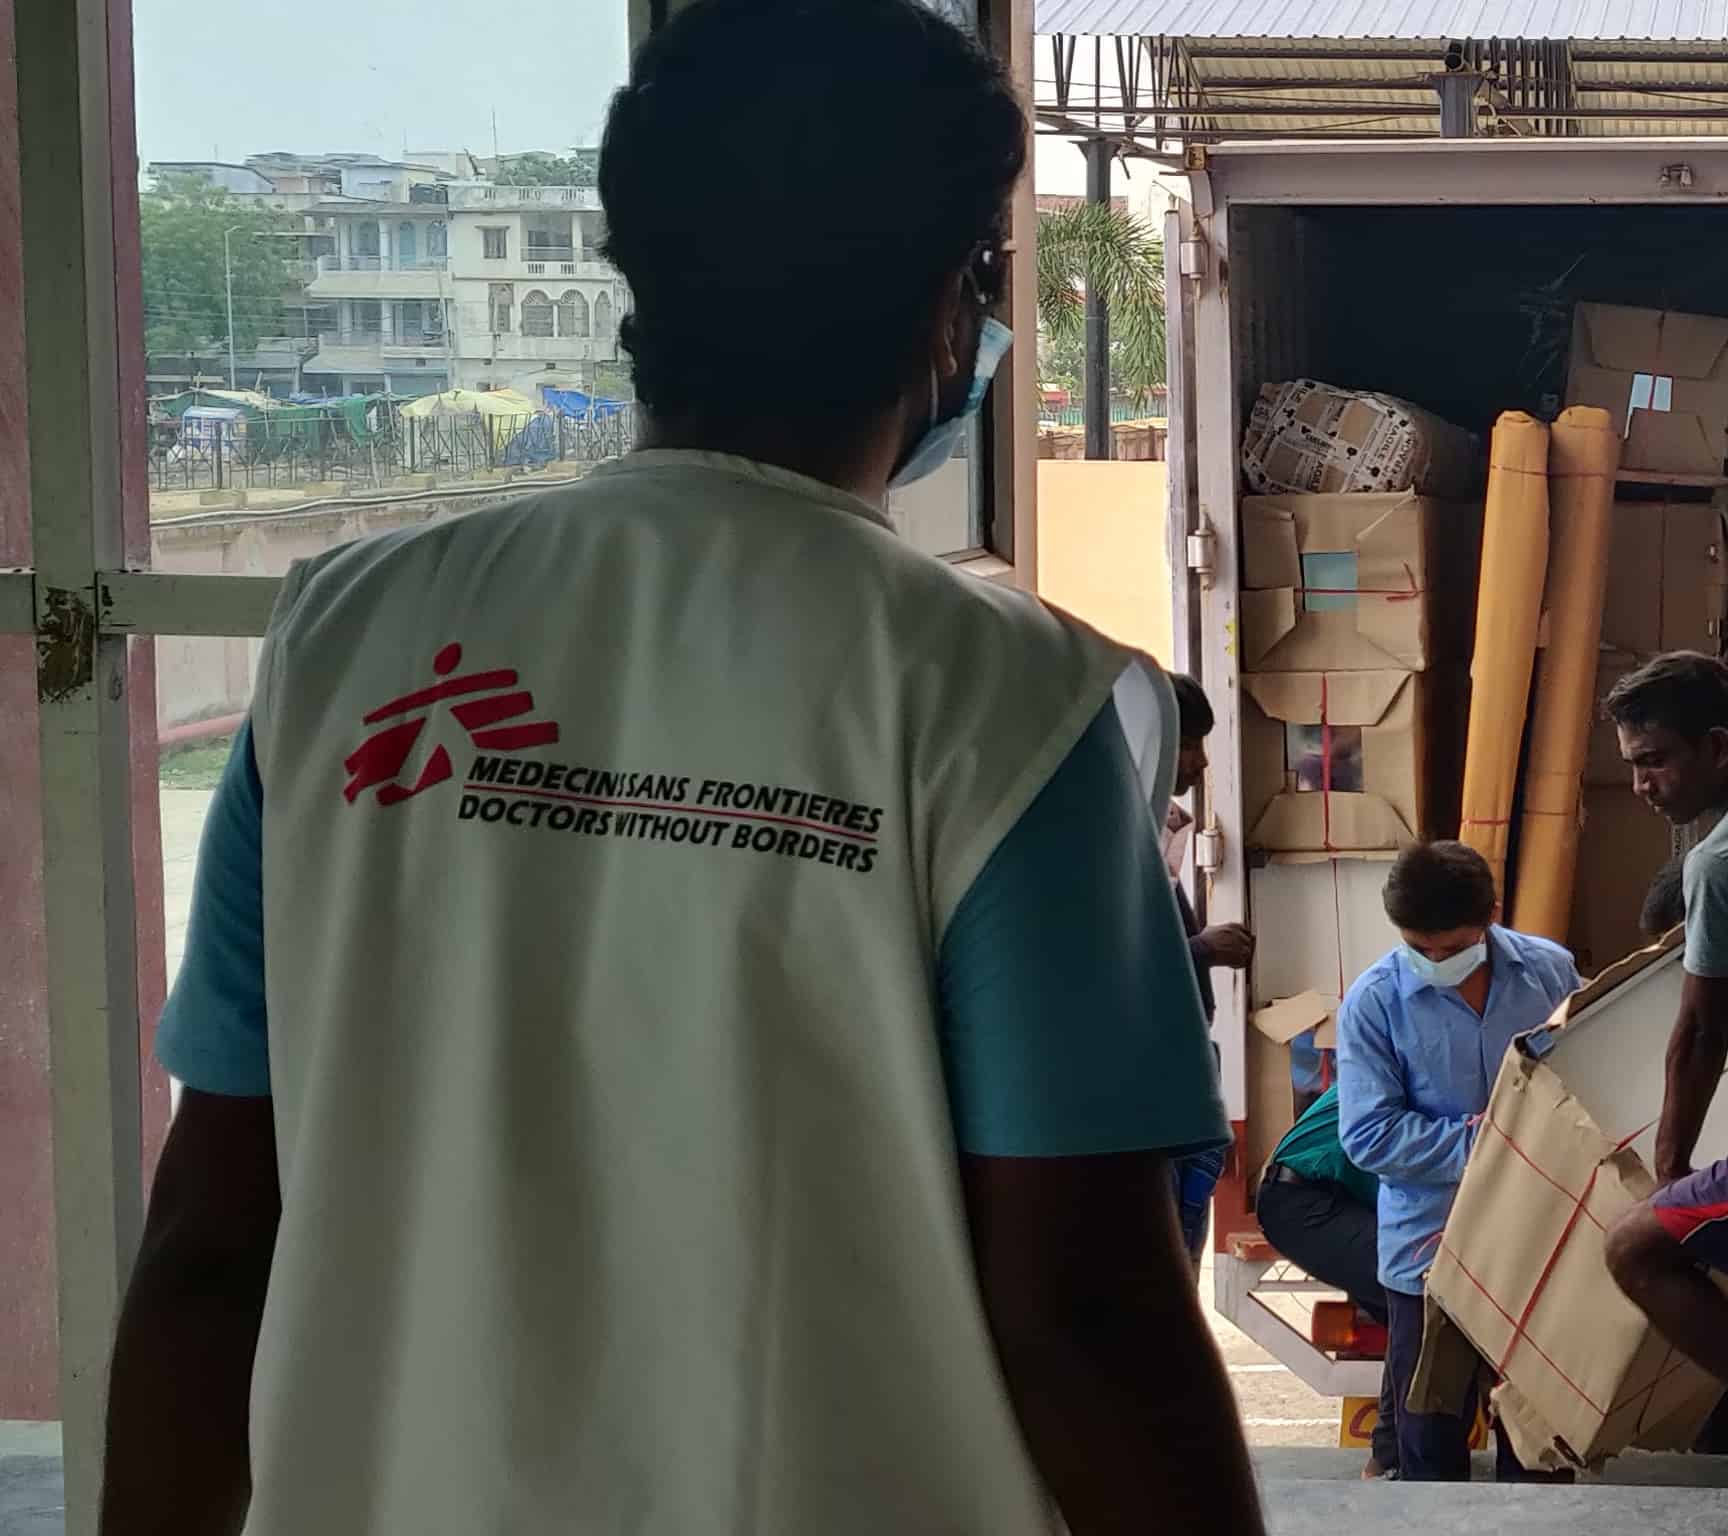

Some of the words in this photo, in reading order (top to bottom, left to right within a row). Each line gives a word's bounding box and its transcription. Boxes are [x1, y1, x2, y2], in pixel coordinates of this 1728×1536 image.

[458, 794, 613, 836] DOCTORS
[615, 811, 730, 847] WITHOUT
[732, 825, 880, 873] BORDERS
[626, 773, 690, 802] SANS
[697, 779, 885, 834] FRONTIERES
